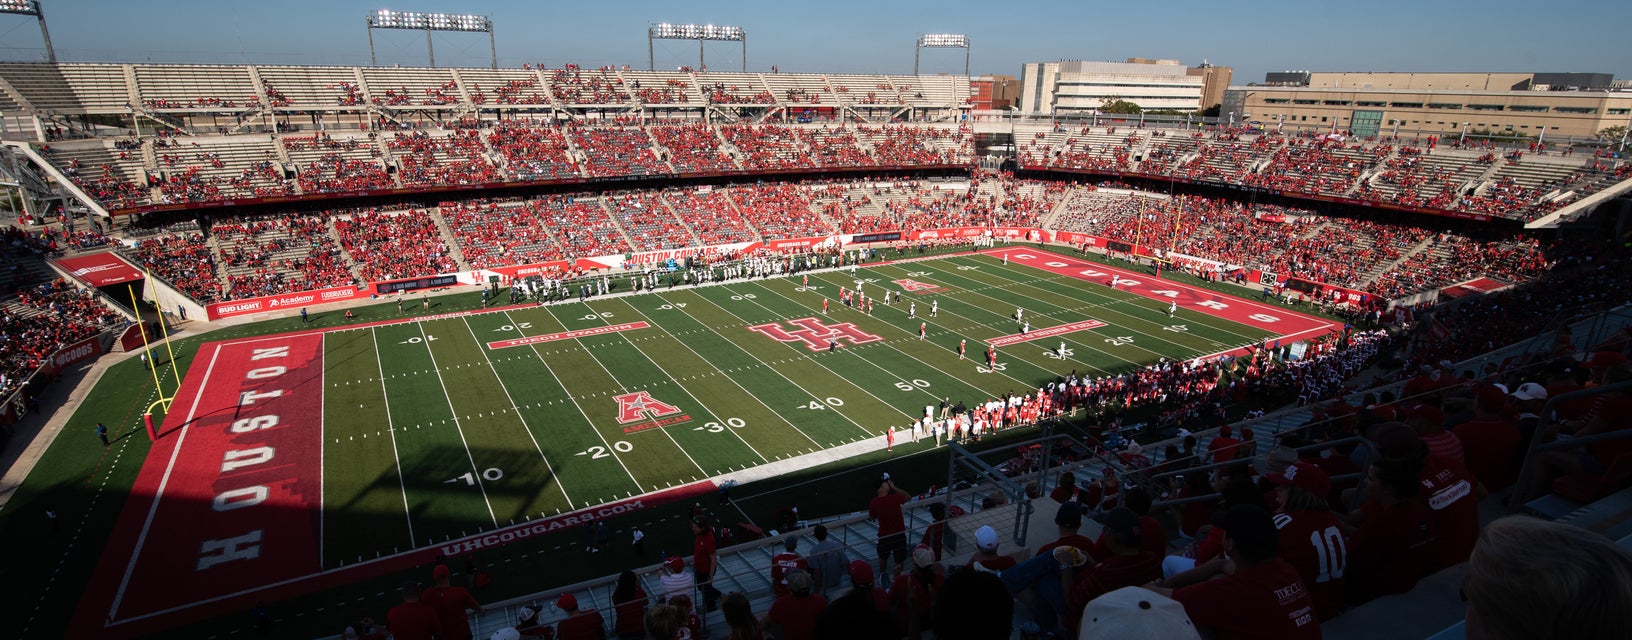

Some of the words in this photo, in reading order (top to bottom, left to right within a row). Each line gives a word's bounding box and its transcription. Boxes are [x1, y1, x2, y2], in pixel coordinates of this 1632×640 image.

[624, 251, 671, 265] OUSTON
[280, 294, 314, 305] Academy
[219, 306, 235, 314] BUD
[237, 302, 260, 311] LIGHT
[501, 322, 532, 331] 20
[565, 324, 632, 338] STADIUM
[408, 335, 439, 344] 10
[894, 378, 931, 391] 50
[809, 396, 844, 411] 40
[623, 415, 692, 434] AMERICAN
[703, 417, 746, 433] 30
[195, 345, 290, 571] HOUSTON
[586, 441, 633, 460] 20
[458, 468, 503, 486] 10
[440, 499, 646, 557] UHCOUGARS.COM
[1310, 525, 1348, 584] 10
